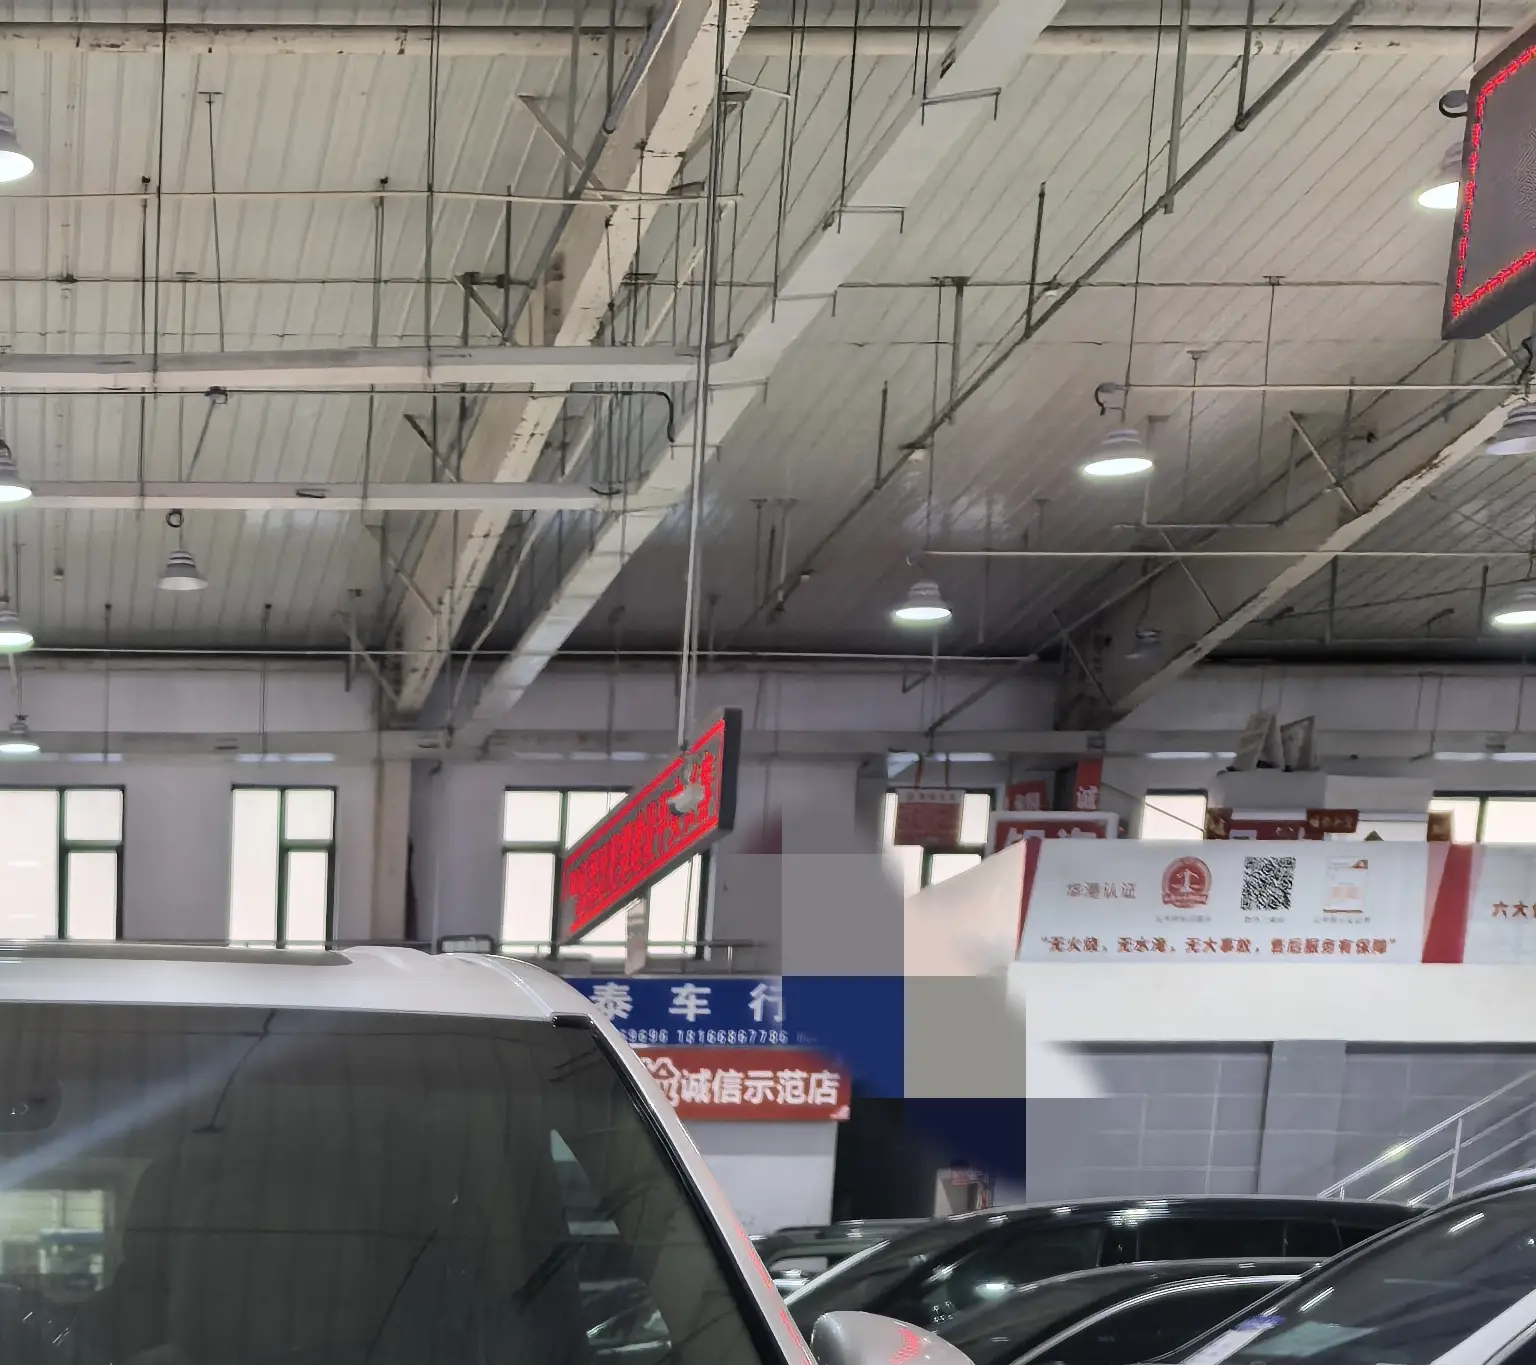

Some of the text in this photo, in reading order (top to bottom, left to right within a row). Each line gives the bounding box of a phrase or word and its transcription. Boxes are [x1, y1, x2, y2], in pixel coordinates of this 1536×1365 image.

[1491, 900, 1536, 919] 六大
[681, 1068, 841, 1106] 诚信示范店
